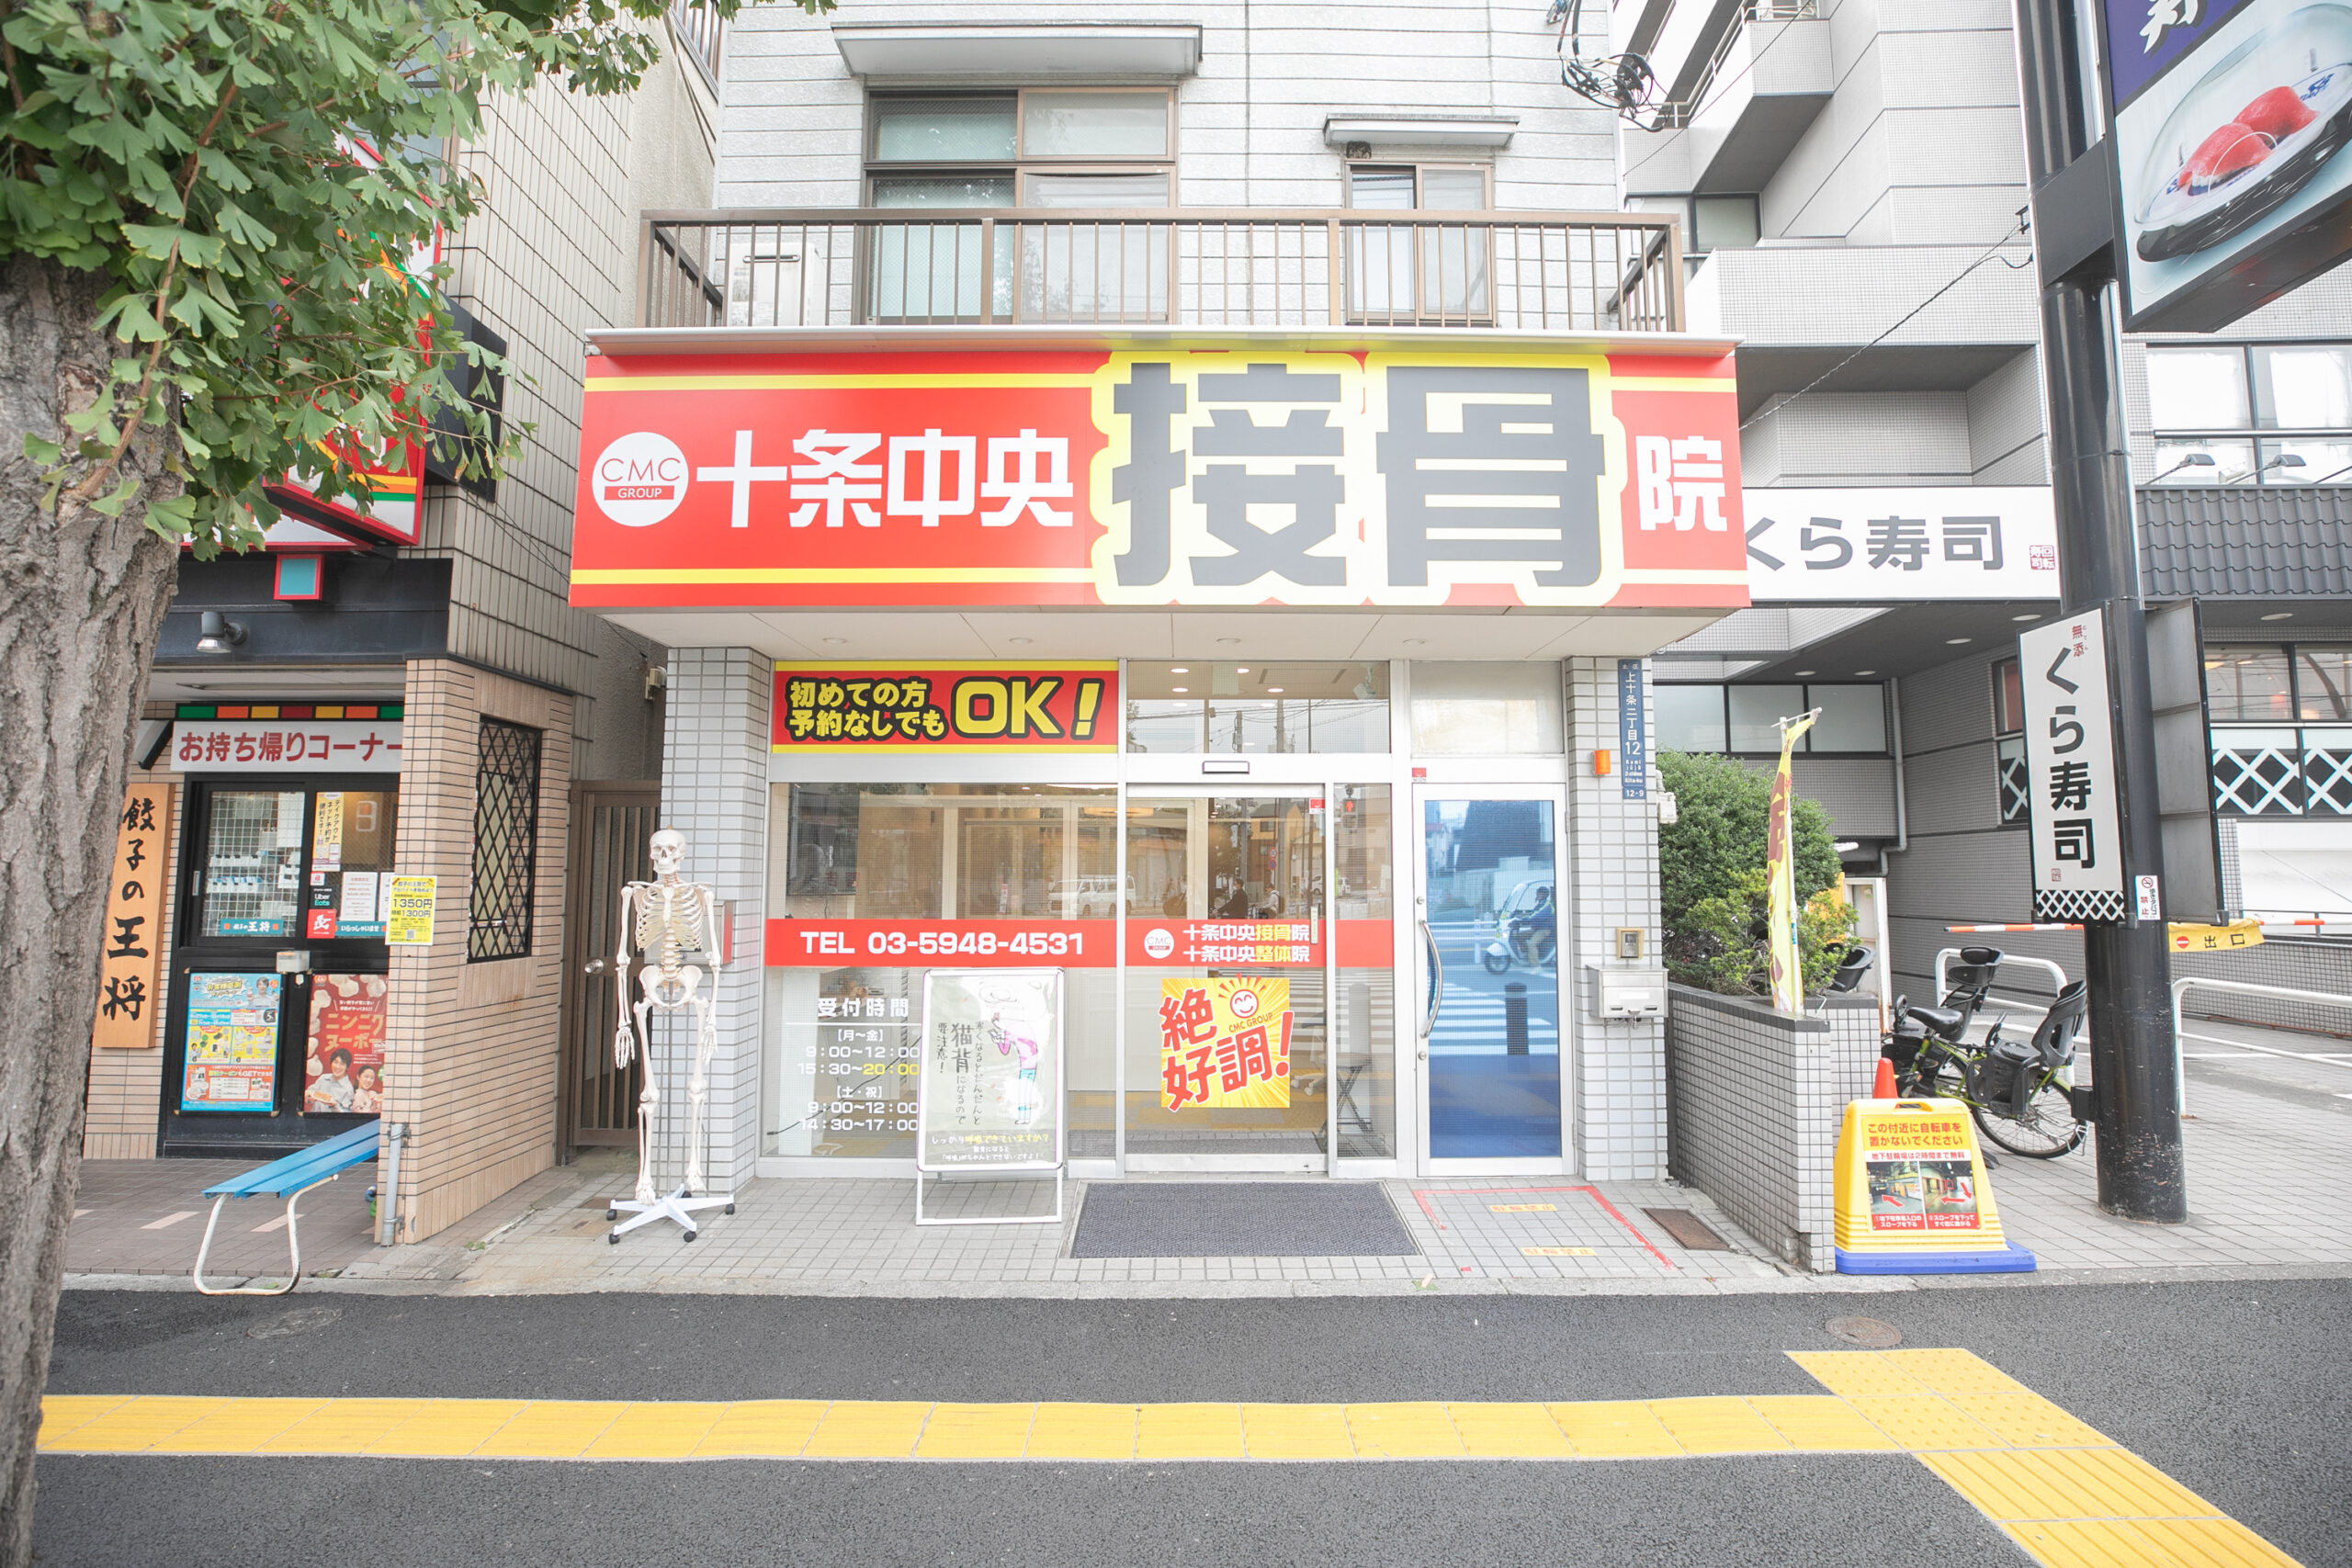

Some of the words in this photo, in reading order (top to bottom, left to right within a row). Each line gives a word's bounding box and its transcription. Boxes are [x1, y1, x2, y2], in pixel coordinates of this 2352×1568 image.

[601, 457, 682, 482] CMC
[695, 362, 1727, 588] 十条中央接骨院
[617, 487, 662, 499] GROUP
[1745, 515, 2004, 571] くら寿司
[790, 681, 927, 707] 初めての方
[1624, 671, 1638, 740] 上十条二丁目
[956, 680, 1101, 736] OK!
[789, 710, 944, 737] 予約なしでも
[179, 732, 402, 761] お持ち帰りコーナー
[1625, 741, 1641, 755] 12
[2046, 647, 2096, 869] くら寿司
[103, 797, 155, 1021] 餃子の王将
[393, 898, 432, 908] 1350円
[800, 931, 854, 953] TEL
[867, 931, 1082, 955] 03-5948-4531
[1183, 924, 1310, 942] 十条中央接骨院
[2204, 933, 2245, 949] 出口
[1183, 945, 1310, 963] 十条中央整体院
[817, 998, 909, 1017] 受付時間
[326, 1013, 385, 1036] ニンニク
[1228, 1021, 1246, 1033] CMC
[1246, 1012, 1273, 1028] GROUP
[324, 1032, 383, 1052] ヌーボー
[1868, 1122, 1962, 1134] この付近に自転車を
[1869, 1135, 1963, 1146] 置かないでください
